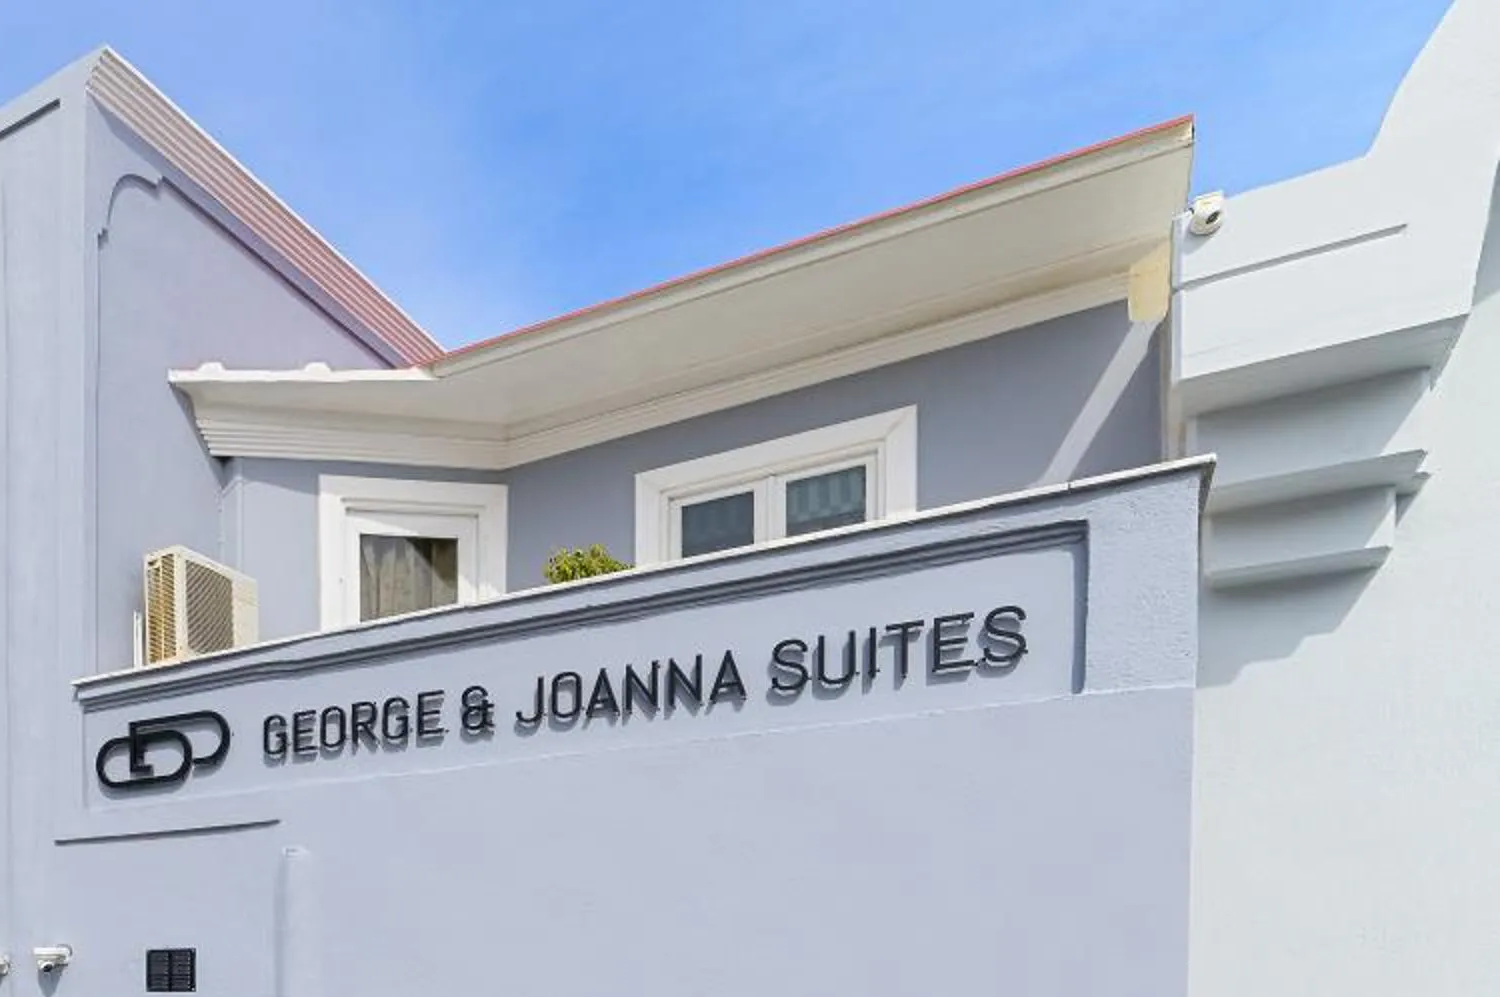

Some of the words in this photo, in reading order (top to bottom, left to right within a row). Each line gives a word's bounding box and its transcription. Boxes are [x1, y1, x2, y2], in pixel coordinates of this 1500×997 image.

[263, 690, 446, 756] GEORGE
[461, 685, 496, 731] &
[515, 649, 748, 724] JOANNA
[772, 605, 1028, 690] SUITES
